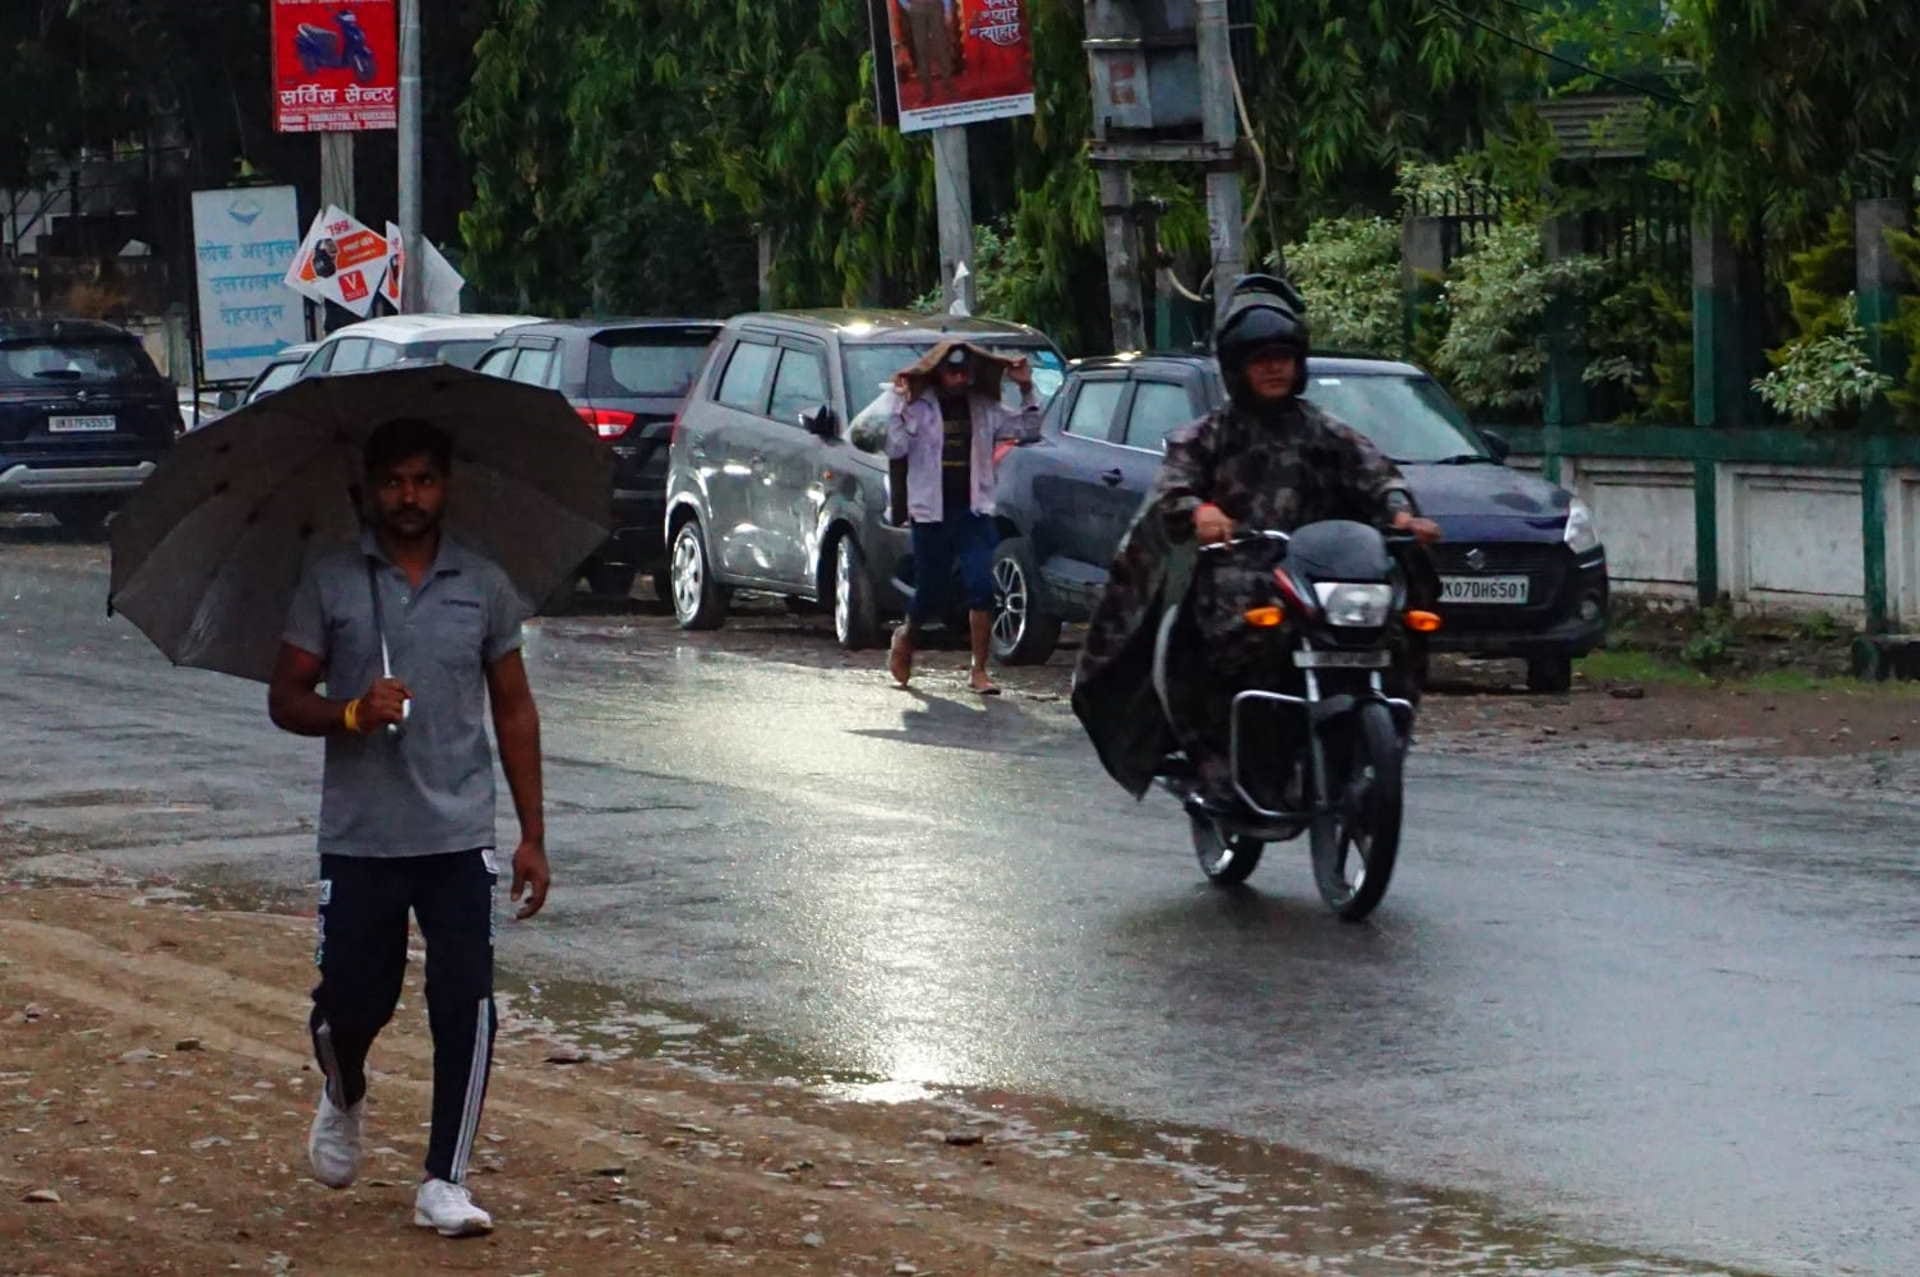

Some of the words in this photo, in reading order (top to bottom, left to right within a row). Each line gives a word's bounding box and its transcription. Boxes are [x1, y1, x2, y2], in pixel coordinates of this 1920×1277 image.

[280, 84, 337, 105] सर्विस
[343, 83, 394, 103] सेन्टर
[1442, 582, 1527, 599] K07DH6501
